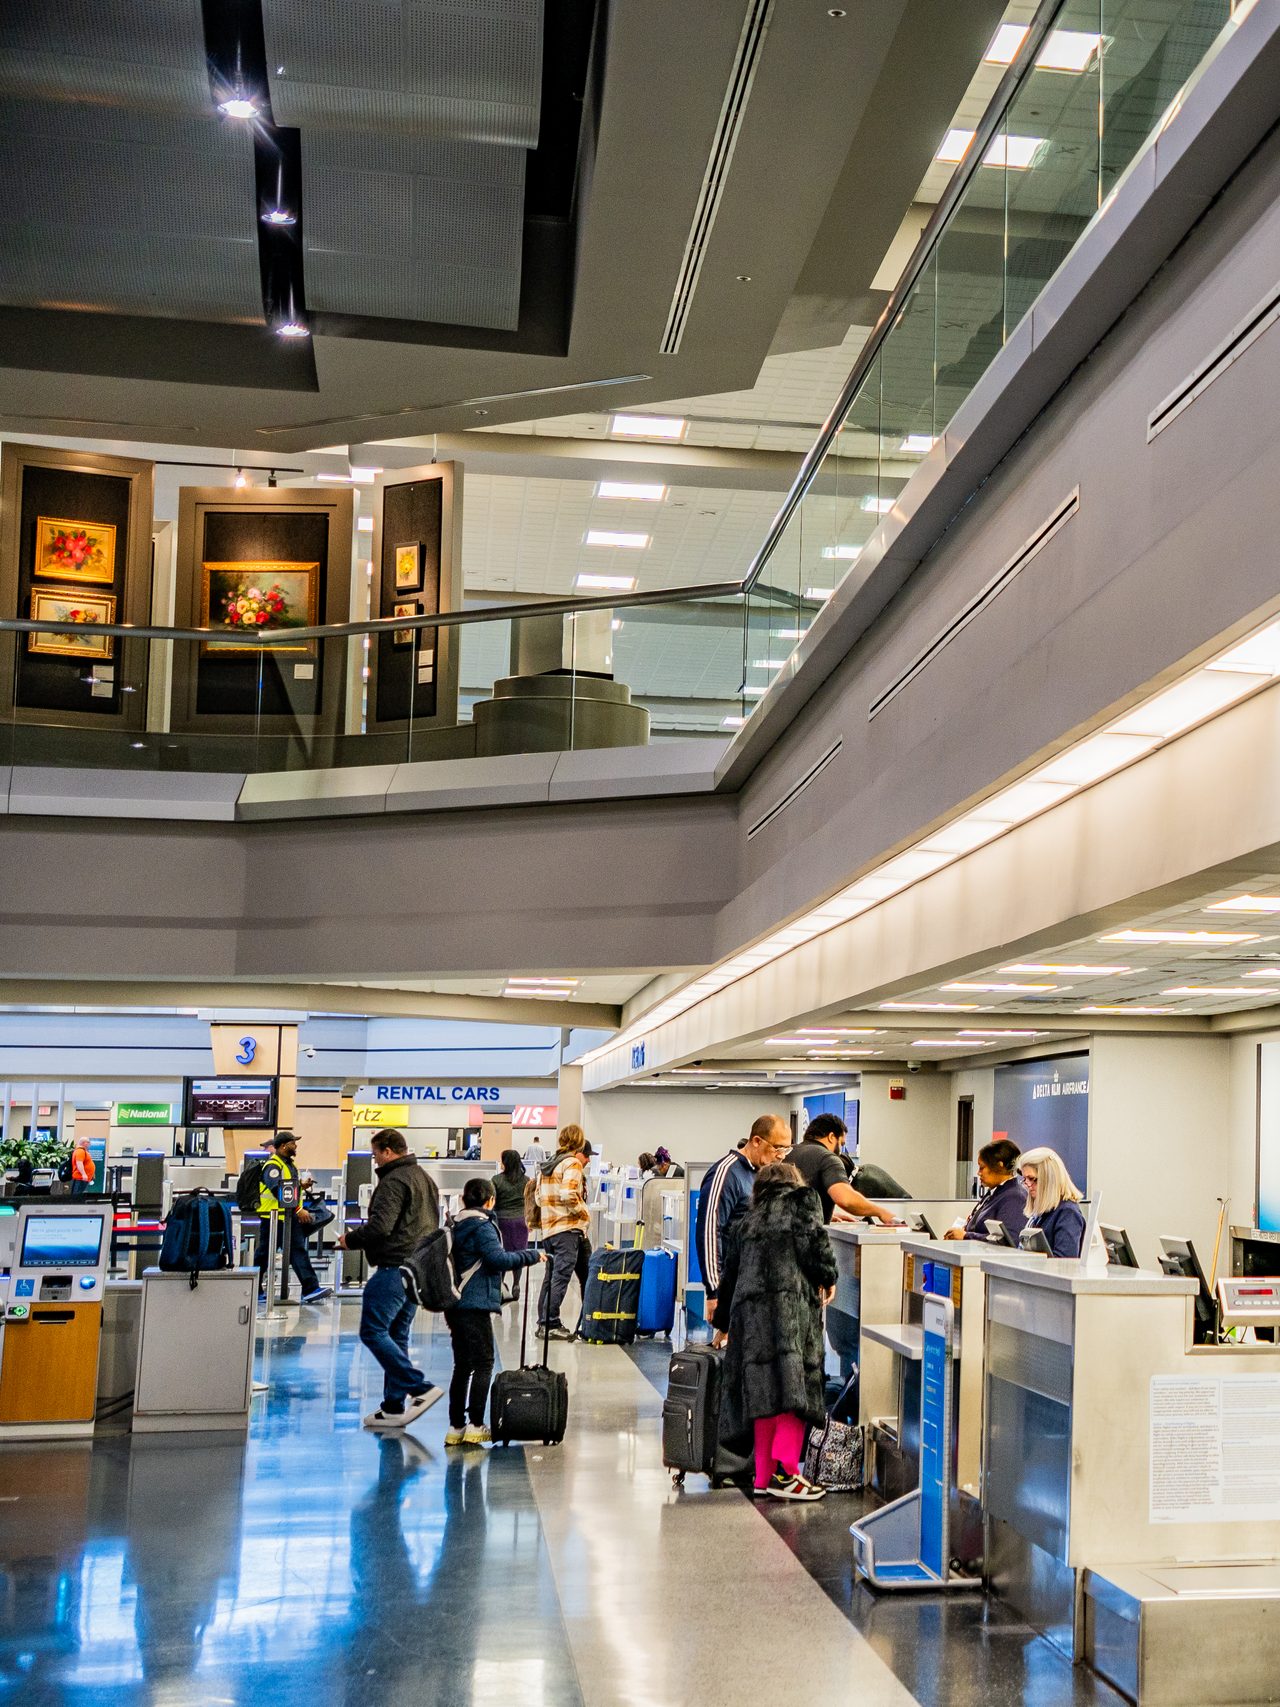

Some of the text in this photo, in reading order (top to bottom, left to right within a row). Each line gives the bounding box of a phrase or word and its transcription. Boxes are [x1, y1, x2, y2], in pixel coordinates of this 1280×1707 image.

[235, 1036, 257, 1065] 3
[377, 1085, 500, 1101] RENTAL CARS
[1036, 1083, 1051, 1098] DELTA
[129, 1109, 169, 1119] National
[353, 1107, 382, 1122] rtz
[511, 1106, 545, 1125] VIS
